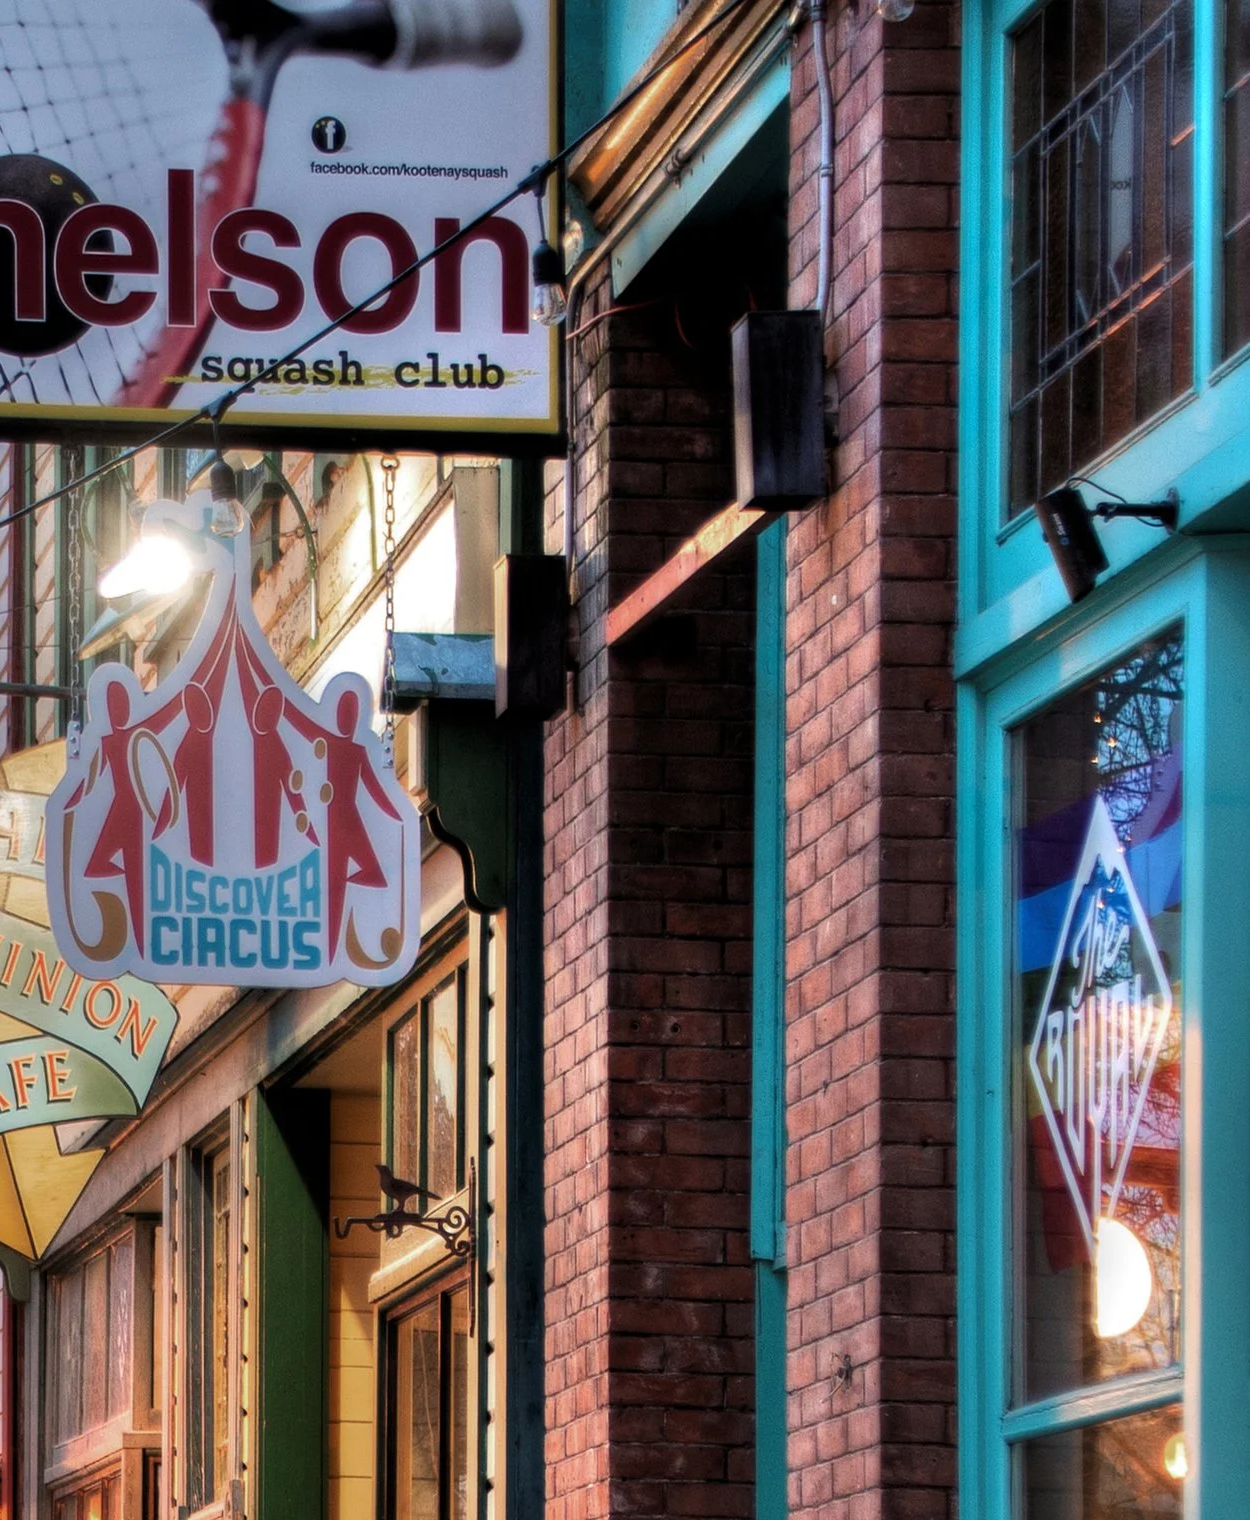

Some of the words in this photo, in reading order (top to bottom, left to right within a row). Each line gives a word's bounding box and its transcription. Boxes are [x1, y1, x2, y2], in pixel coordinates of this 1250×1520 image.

[310, 160, 509, 181] facebook.com/kootenaysquash
[200, 350, 365, 394] squash
[394, 352, 505, 390] club
[150, 842, 322, 919] DISCOVER
[150, 915, 322, 971] CIRCUS
